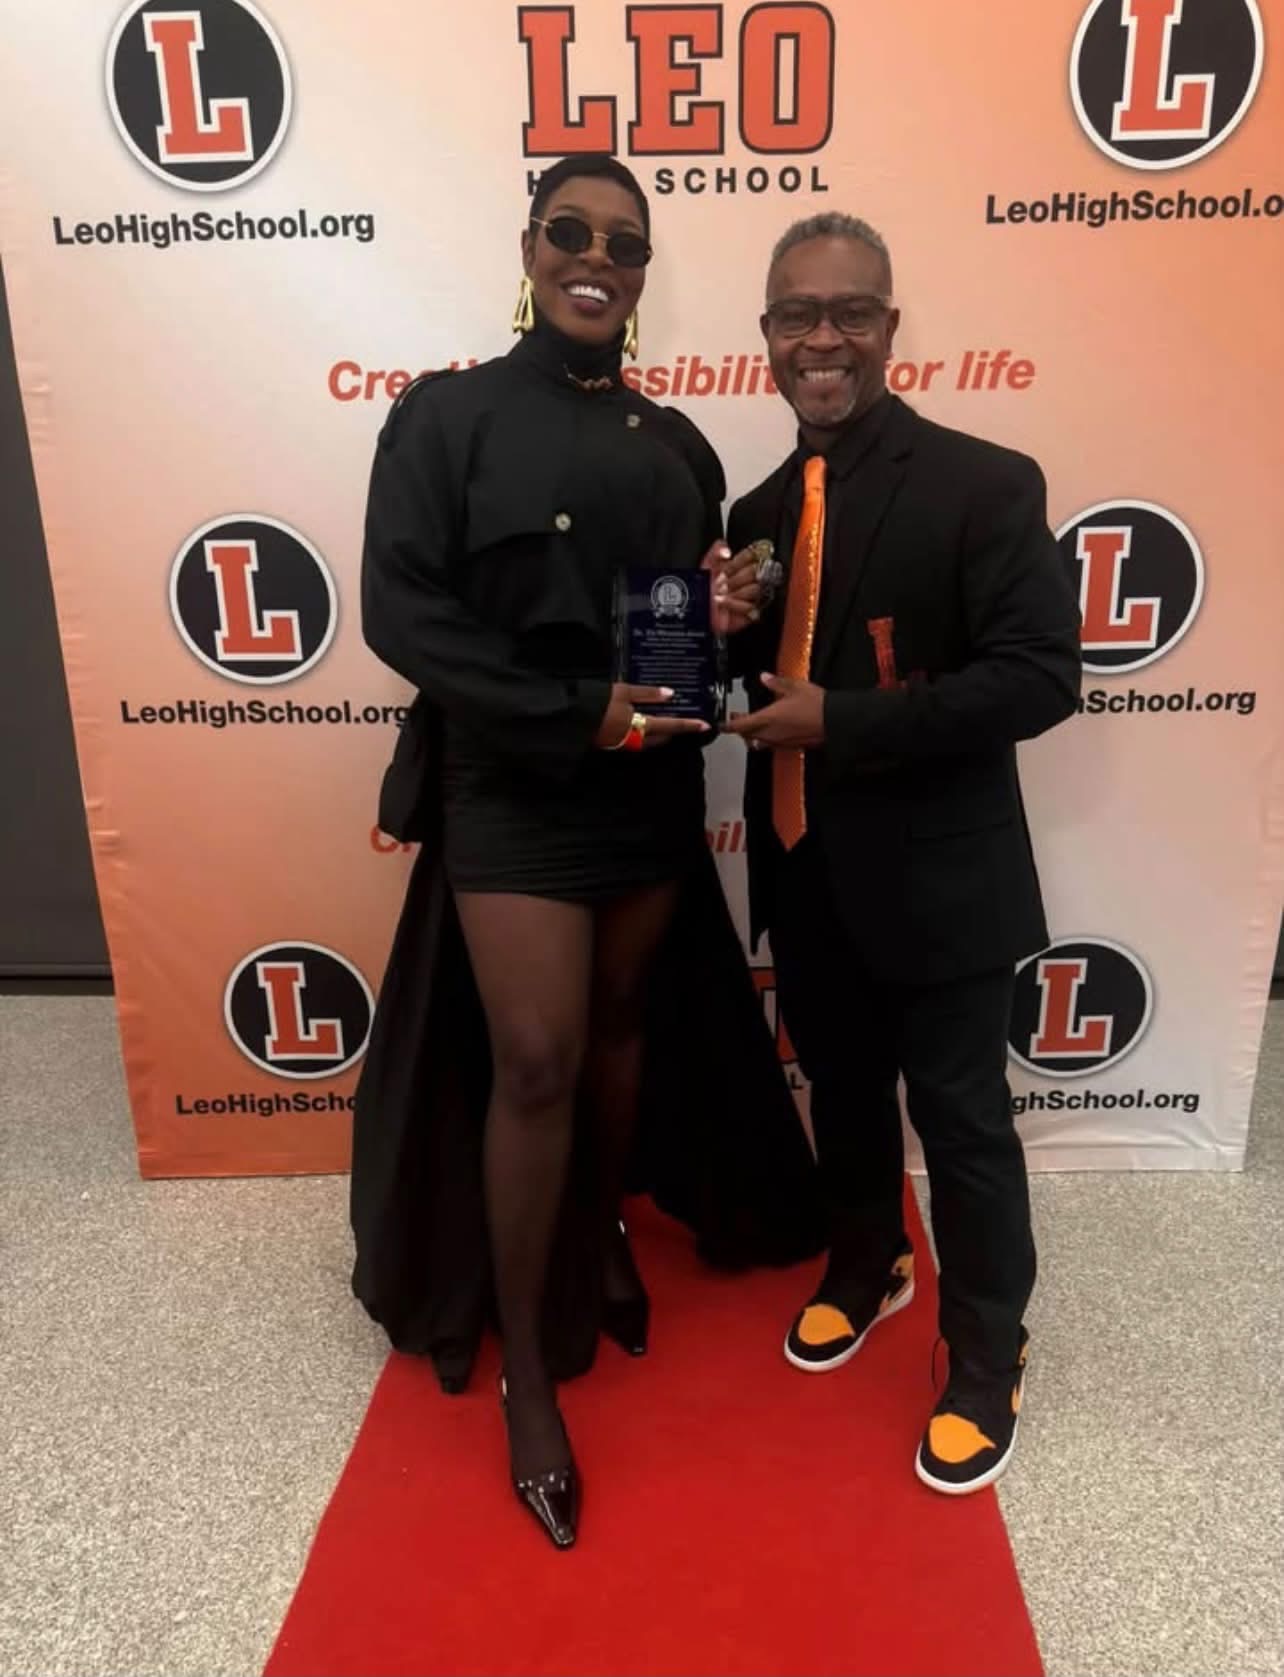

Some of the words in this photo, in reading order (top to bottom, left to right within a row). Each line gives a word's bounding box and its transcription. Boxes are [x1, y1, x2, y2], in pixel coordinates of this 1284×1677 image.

[142, 9, 254, 165] L
[518, 2, 835, 156] LEO
[1111, 0, 1216, 140] L
[655, 166, 829, 196] SCHOOL
[985, 188, 1284, 228] LeoHighSchool.o
[53, 209, 376, 249] LeoHighSchool.org
[620, 354, 778, 397] ssibilit
[884, 354, 945, 392] or
[956, 350, 1036, 390] life
[203, 540, 303, 661] L
[1076, 525, 1162, 650] L
[121, 700, 410, 729] LeoHighSchool.org
[1076, 687, 1257, 715] School.org
[256, 961, 345, 1061] L
[1029, 958, 1113, 1059] L
[1011, 1088, 1200, 1115] ghSchool.org
